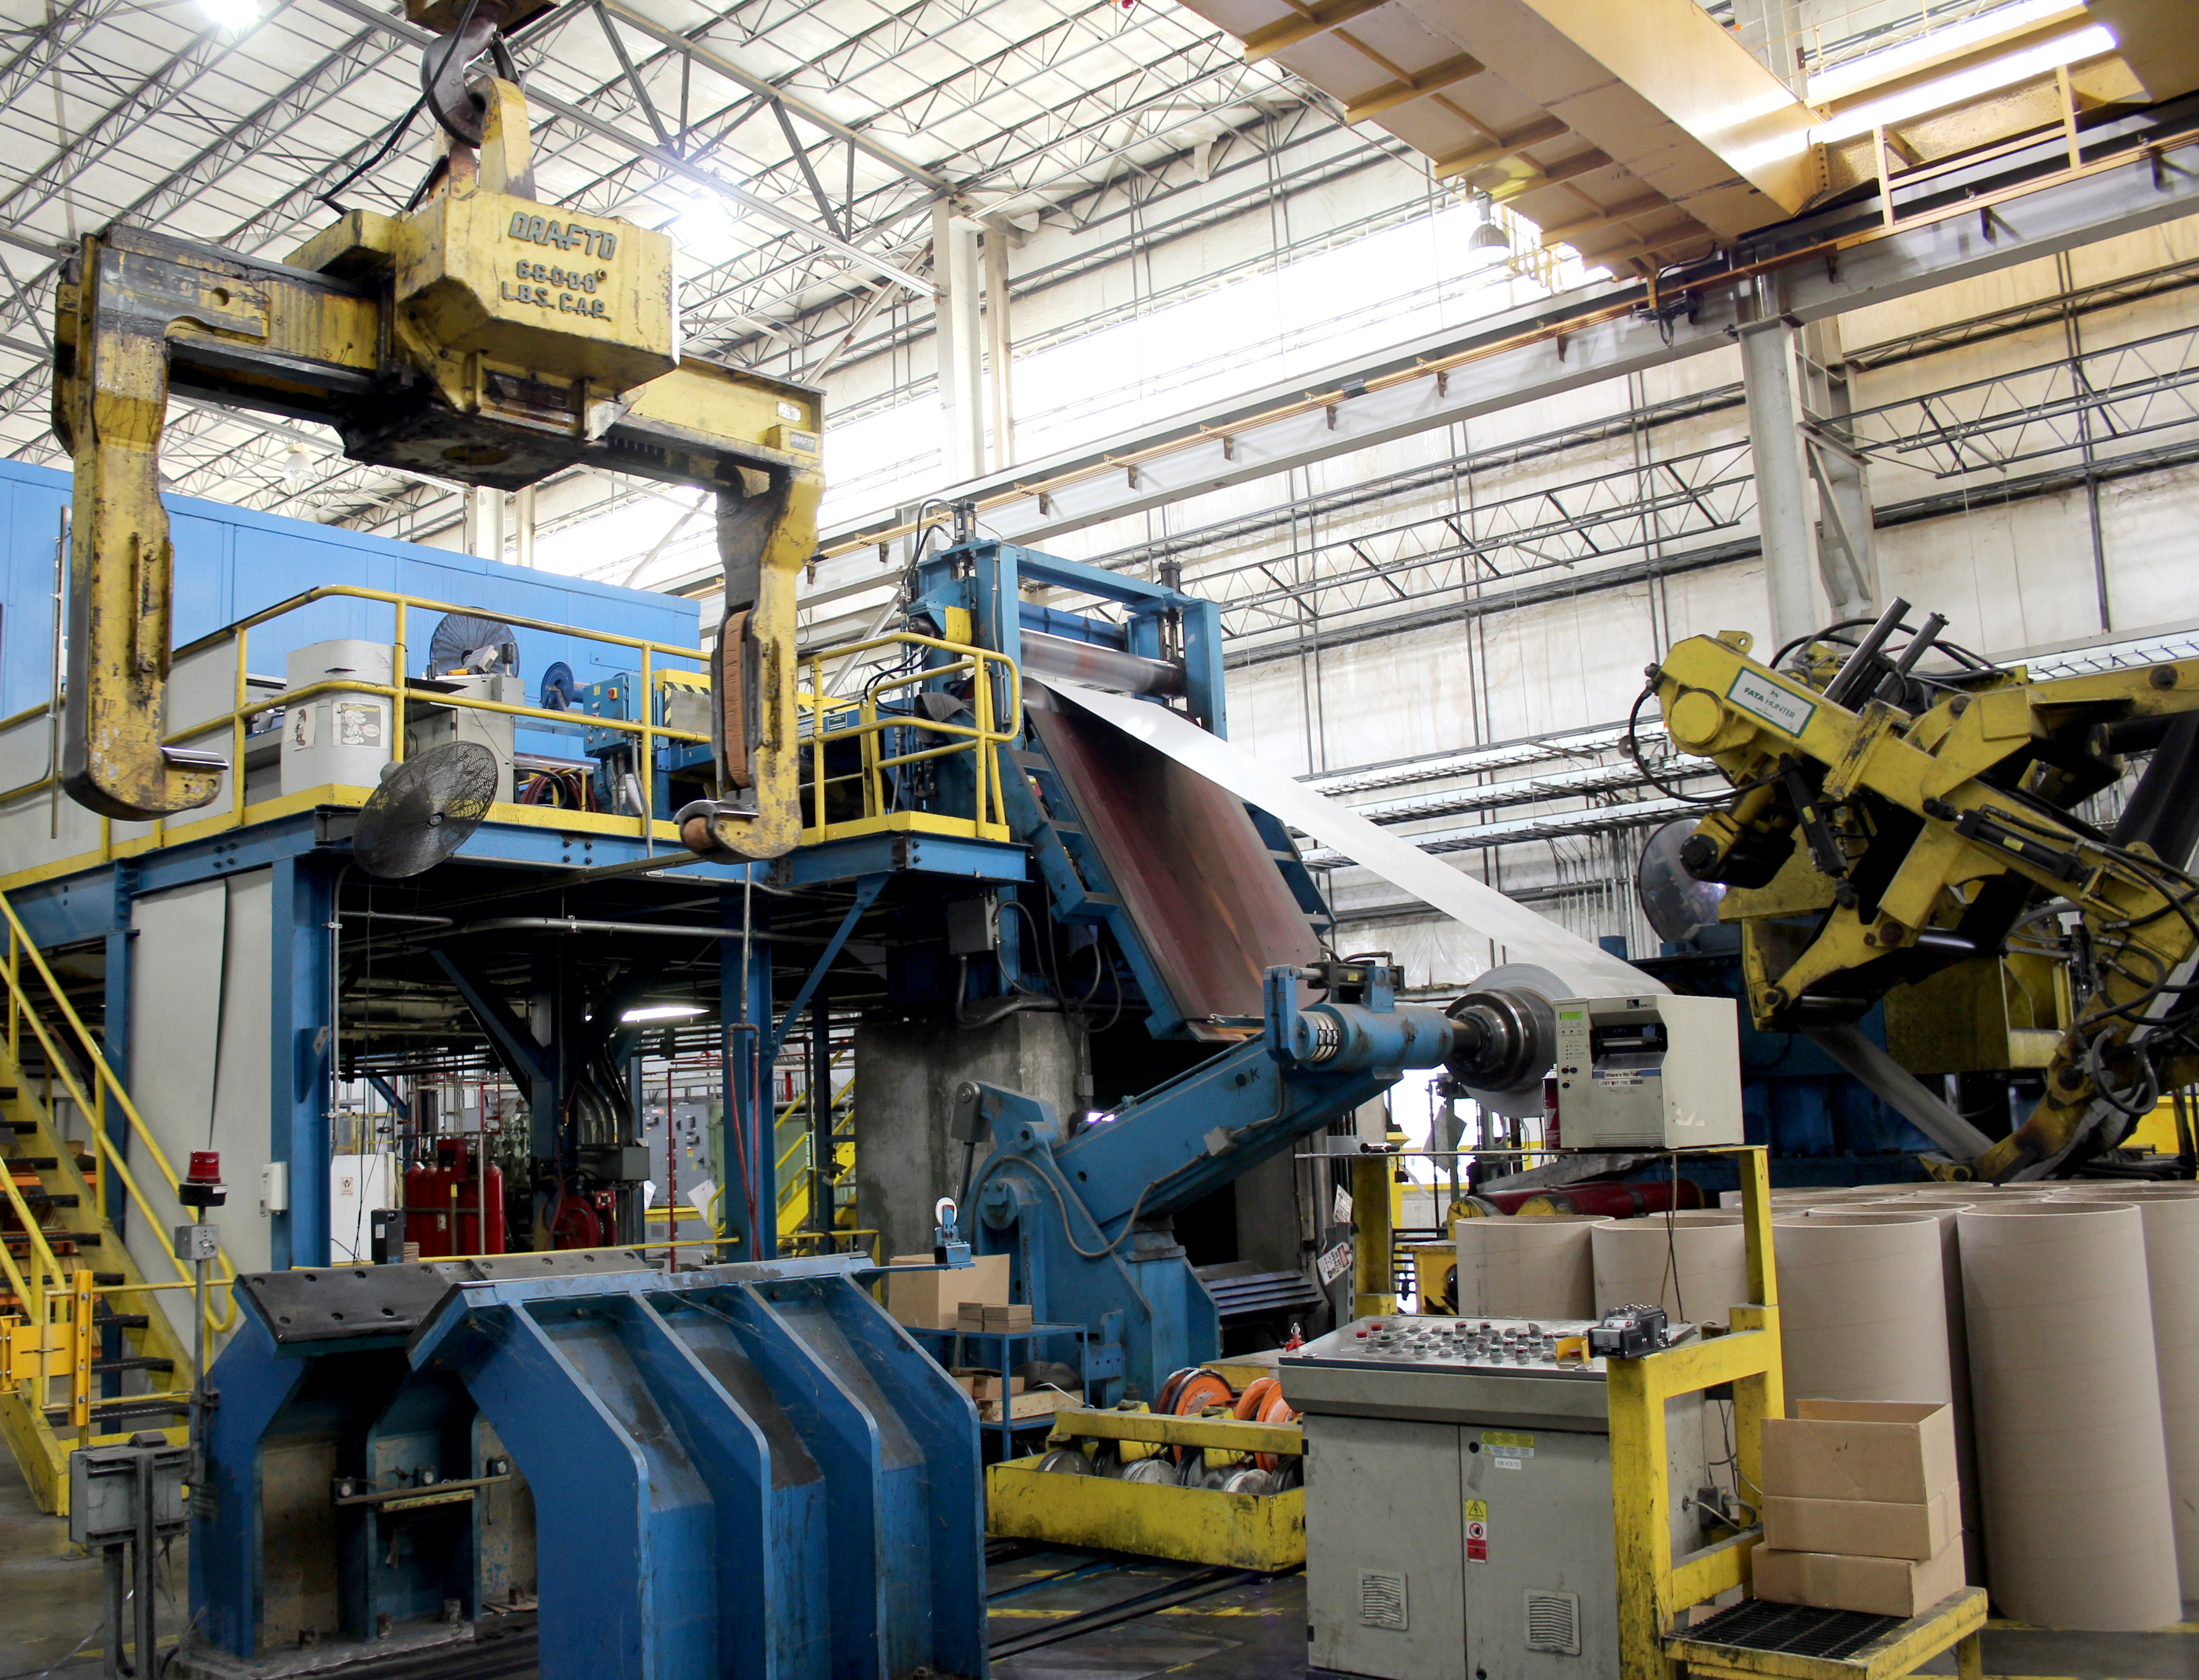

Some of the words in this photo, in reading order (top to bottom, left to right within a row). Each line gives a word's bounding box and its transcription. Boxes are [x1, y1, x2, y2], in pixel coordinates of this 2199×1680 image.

[509, 211, 617, 260] DRAFTO
[517, 260, 597, 293] 66000
[1745, 687, 1764, 702] FATA
[1765, 698, 1796, 719] HUNTER
